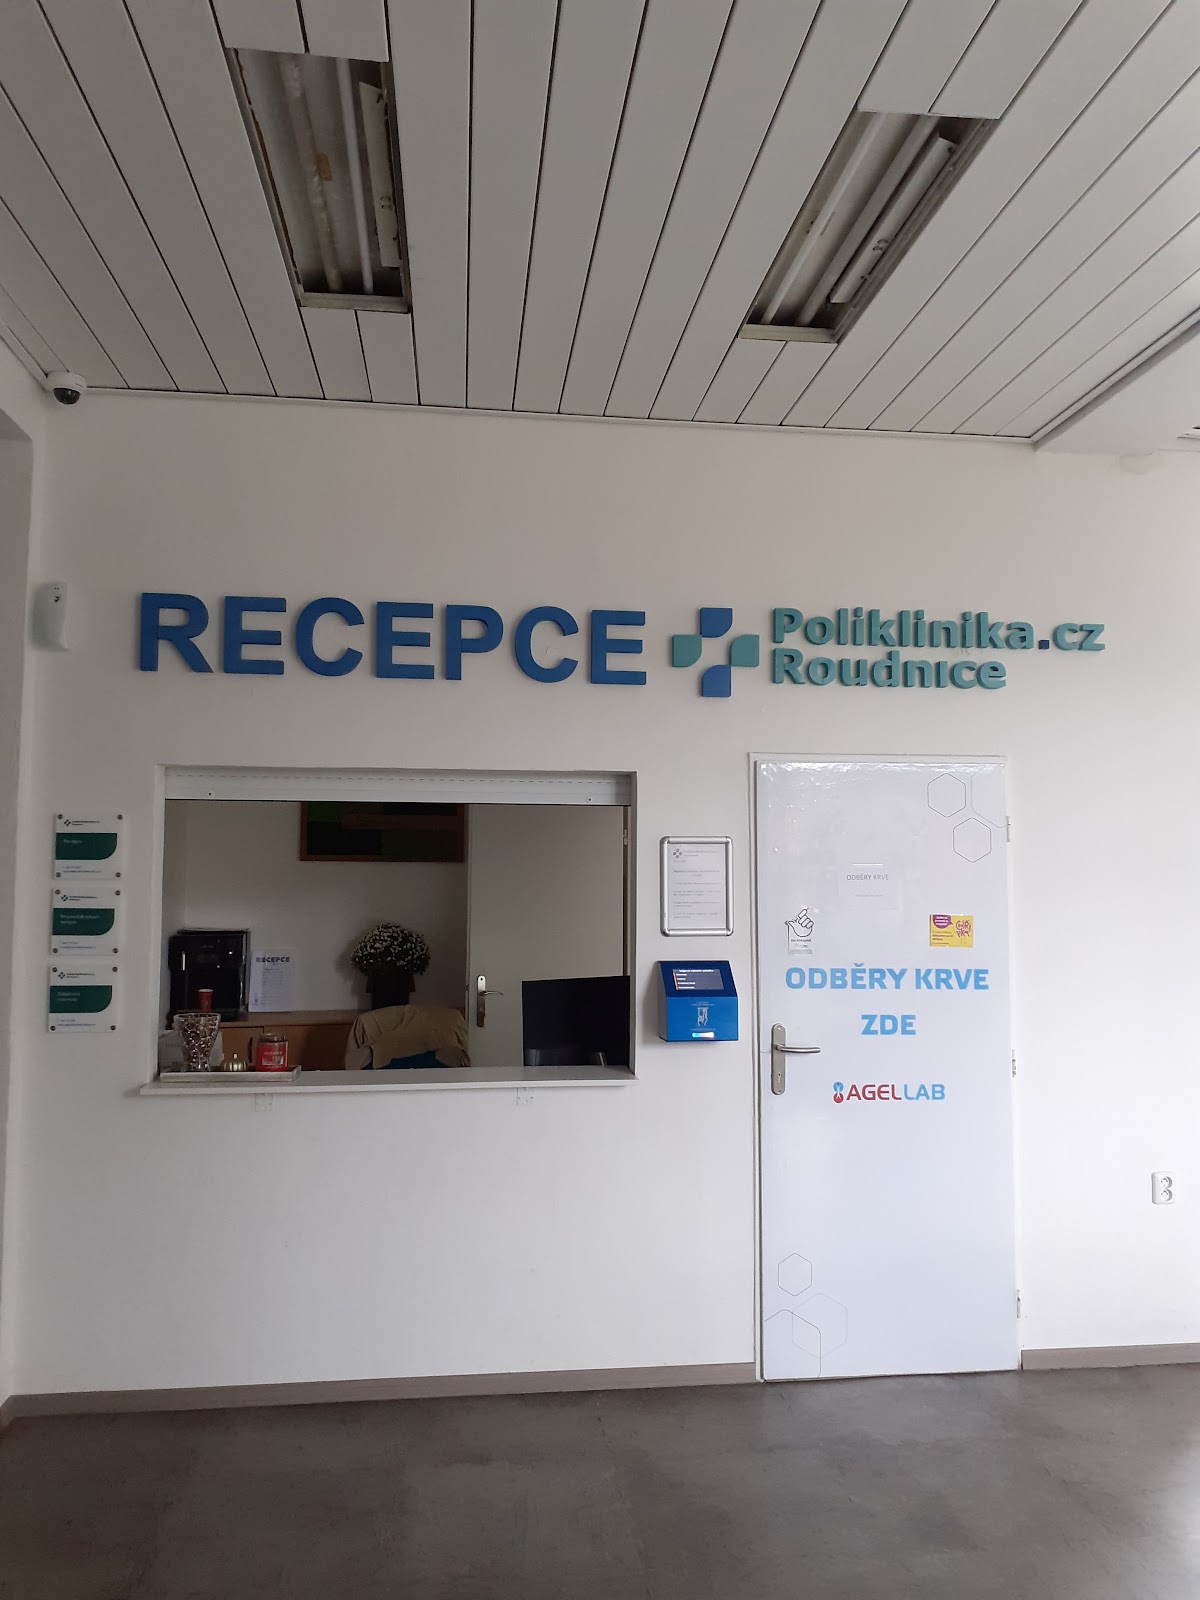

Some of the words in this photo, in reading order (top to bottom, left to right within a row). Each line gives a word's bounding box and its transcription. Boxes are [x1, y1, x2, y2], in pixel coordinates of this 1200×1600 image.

[139, 593, 647, 686] RECEPCE
[771, 608, 1105, 652] Poliklinika.cz
[771, 649, 1007, 689] Roudnice
[785, 962, 908, 990] ODBĚRY
[914, 967, 991, 991] KRVE
[860, 1014, 917, 1036] ZDE
[846, 1083, 946, 1101] AGELLAB
